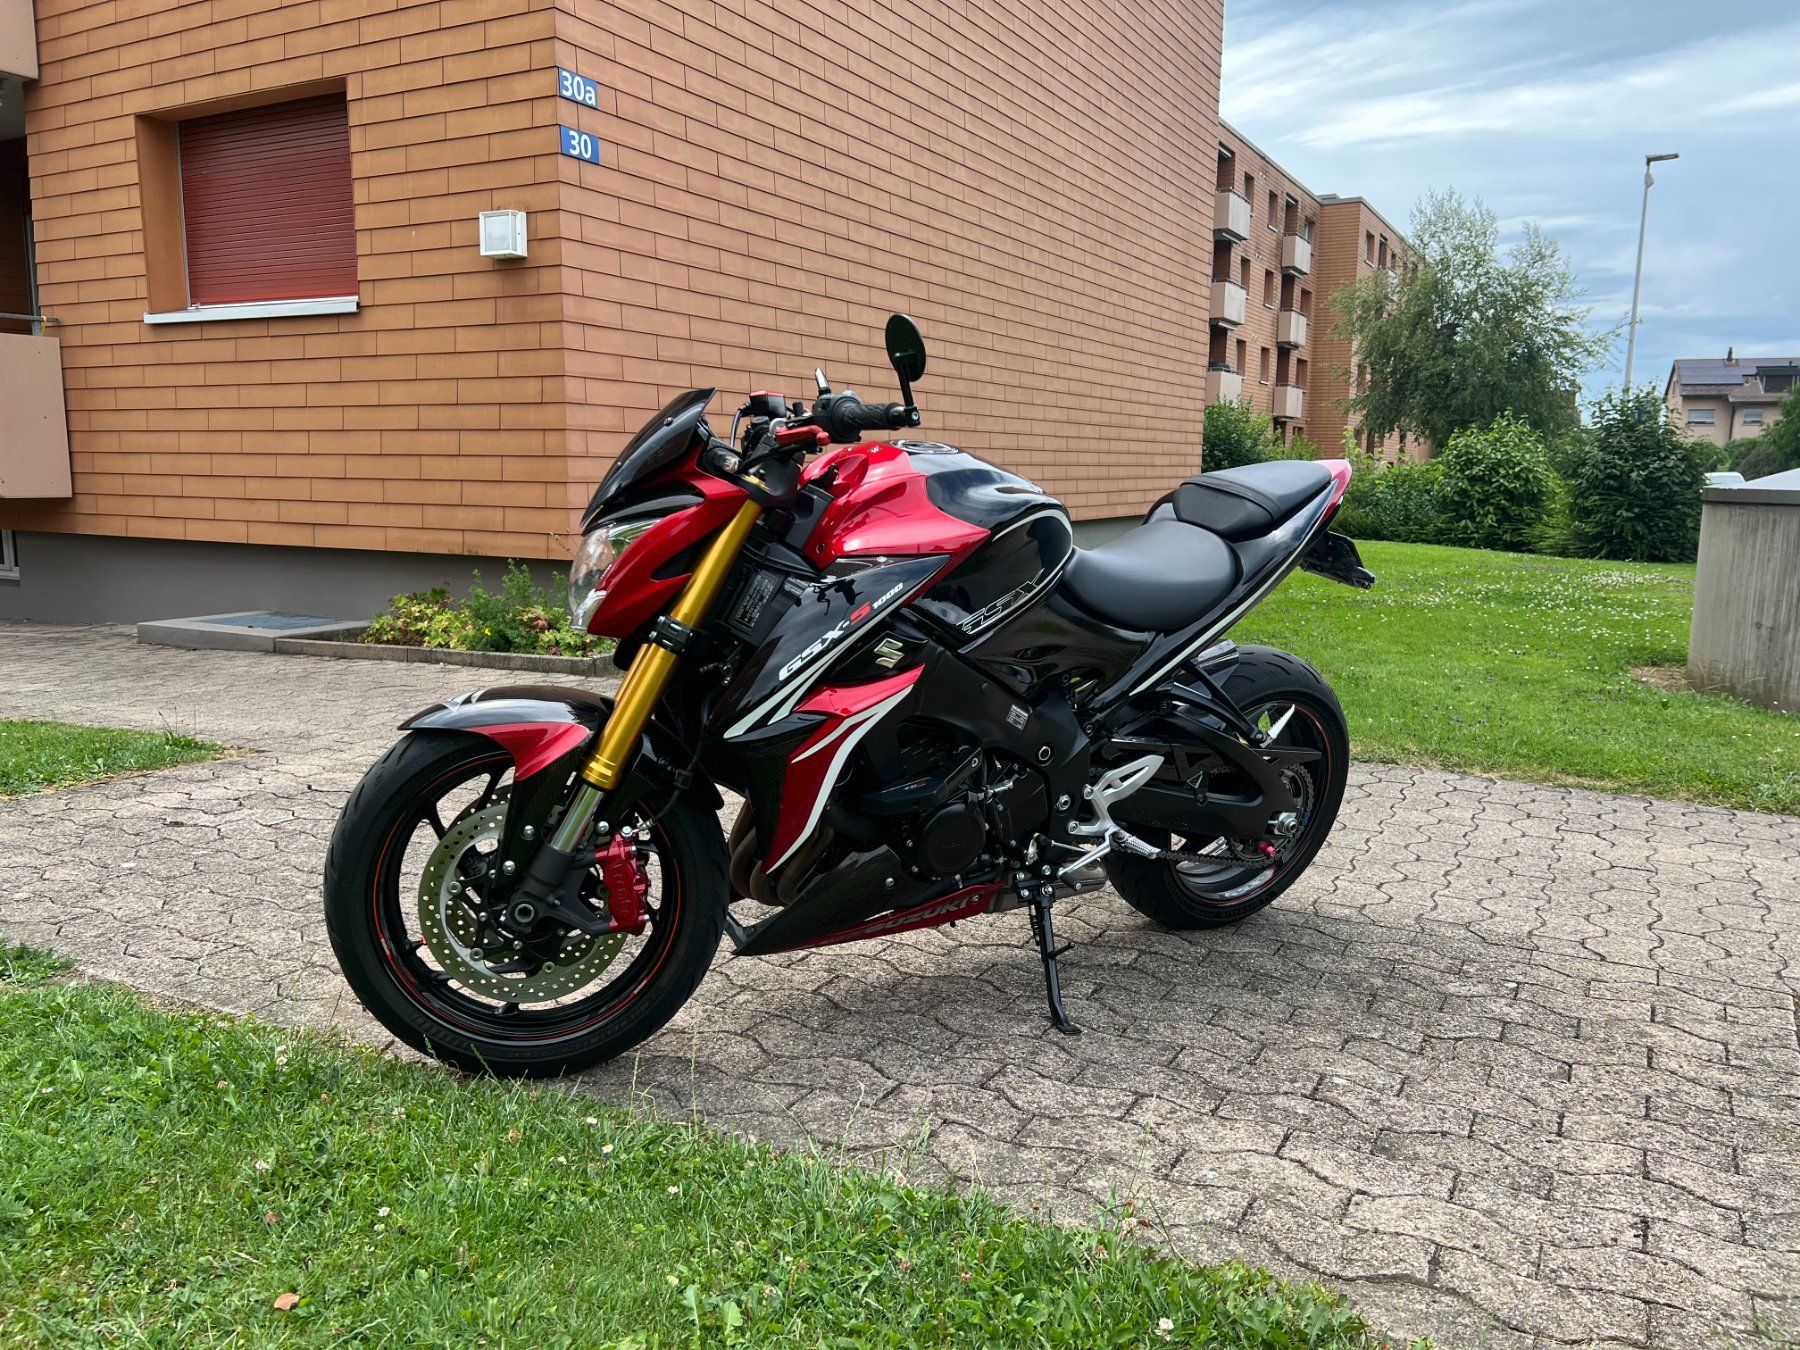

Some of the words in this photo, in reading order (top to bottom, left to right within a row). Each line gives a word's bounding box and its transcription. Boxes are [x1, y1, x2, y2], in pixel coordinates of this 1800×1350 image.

[561, 71, 596, 105] 30a
[569, 130, 592, 159] 30
[872, 582, 904, 610] 1000
[865, 897, 969, 934] SUZUKI
